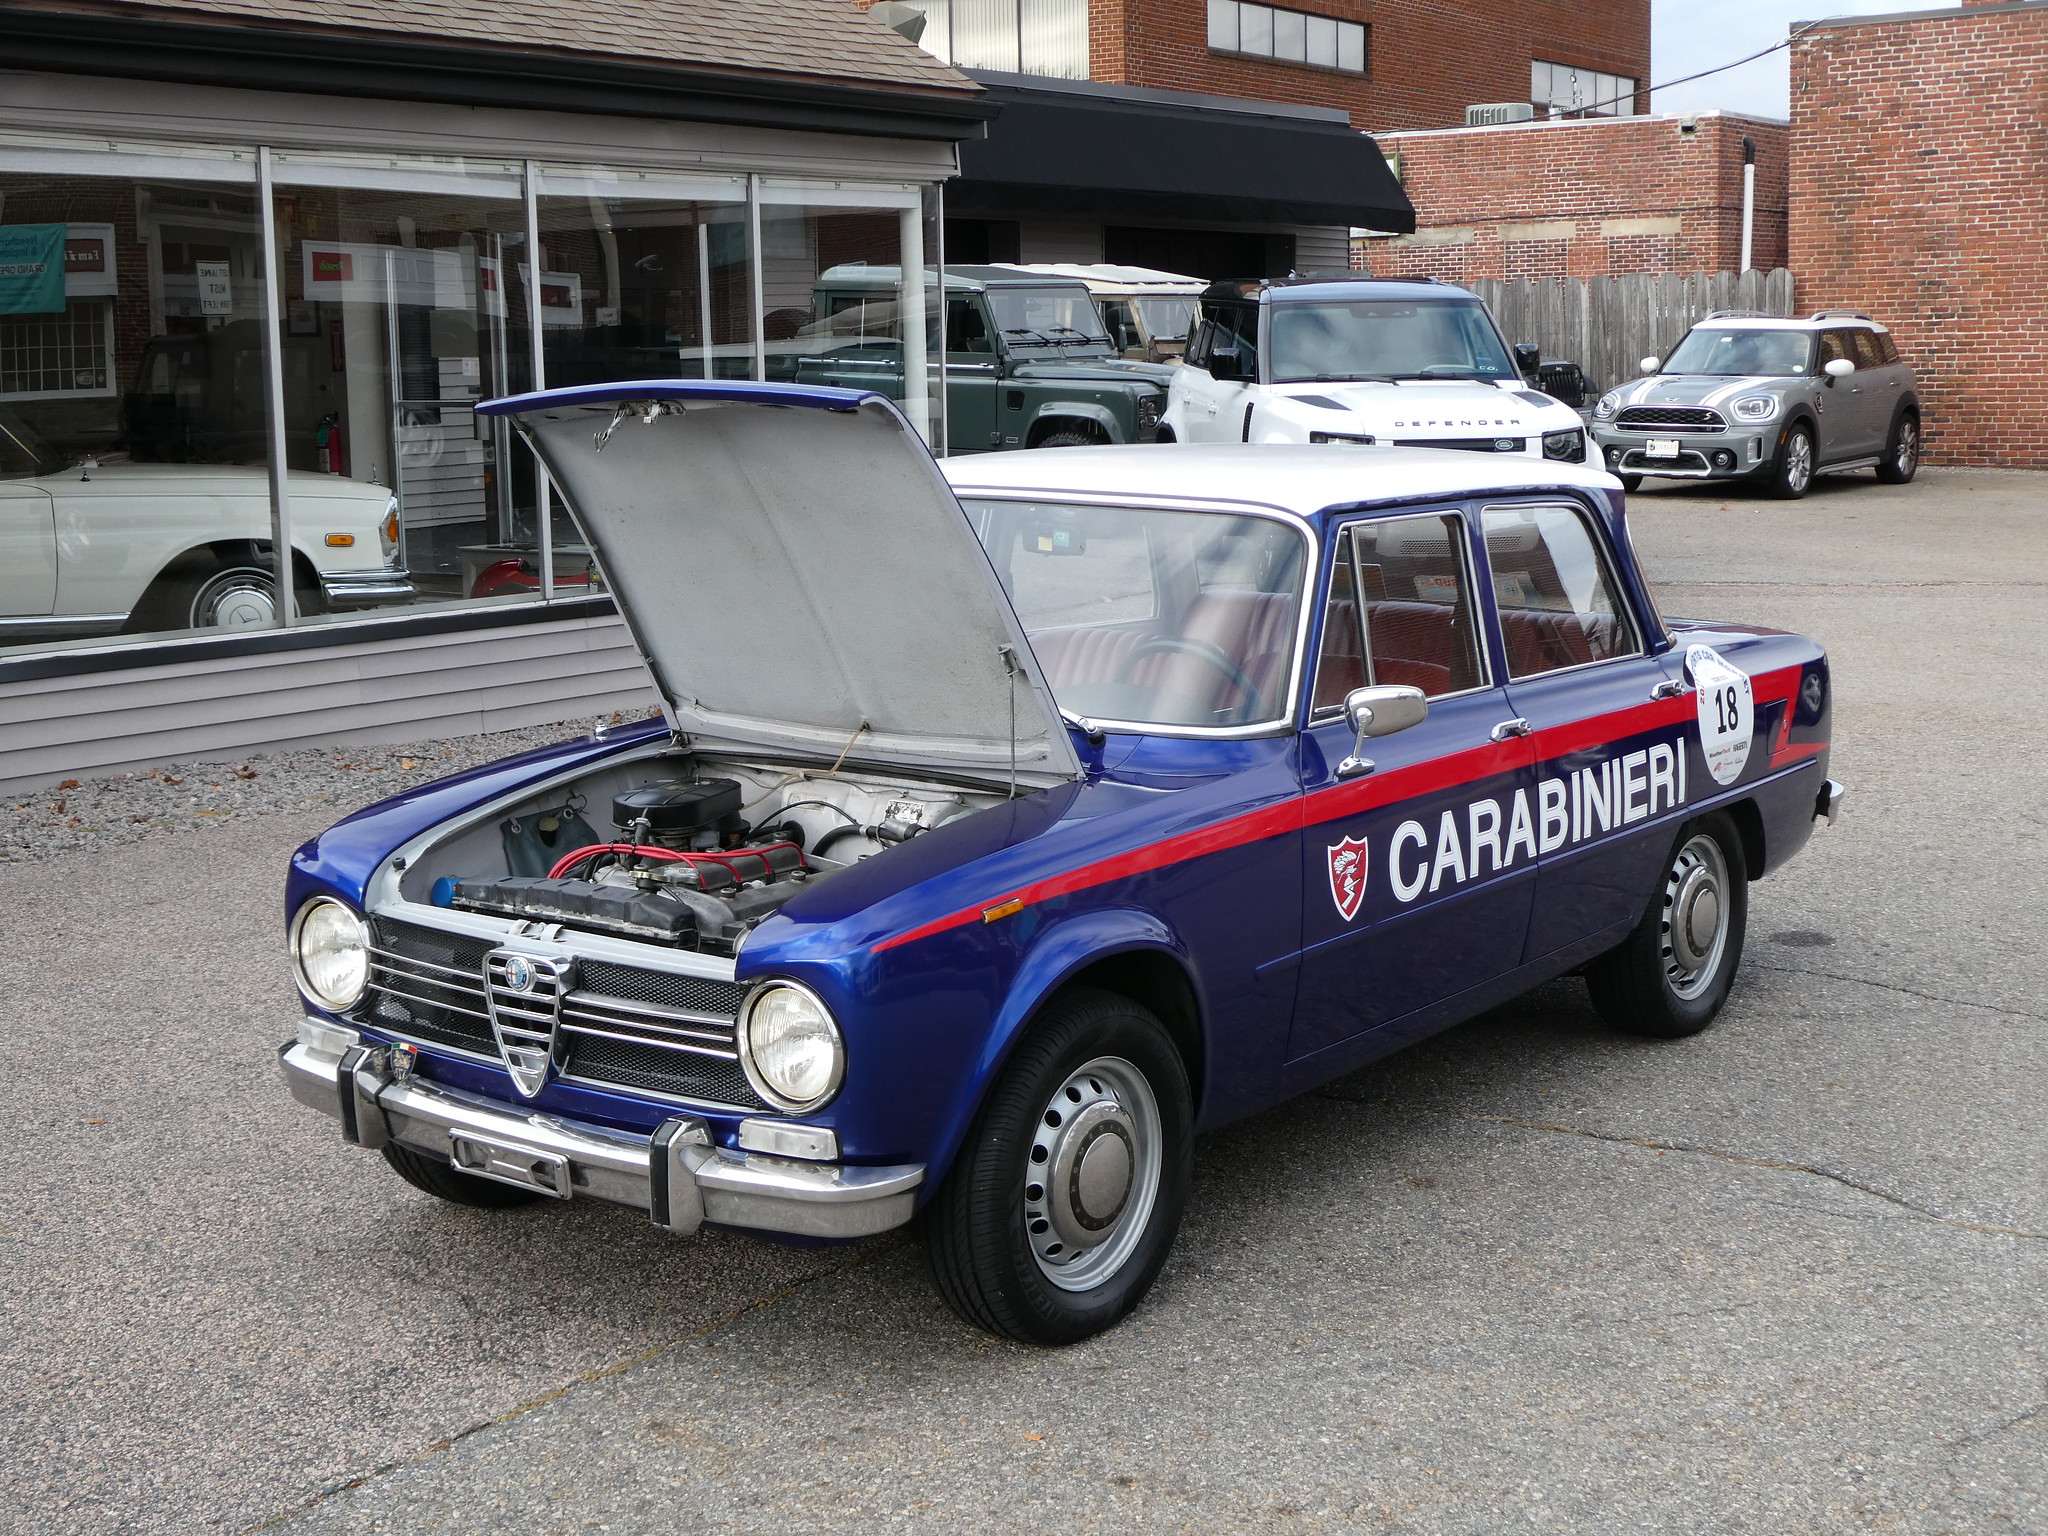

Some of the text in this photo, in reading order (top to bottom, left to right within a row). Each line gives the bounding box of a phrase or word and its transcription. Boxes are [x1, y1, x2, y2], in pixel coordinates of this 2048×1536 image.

[1394, 419, 1521, 427] DEFENDER
[1714, 685, 1739, 735] 18
[1389, 736, 1686, 903] CARABINIERI
